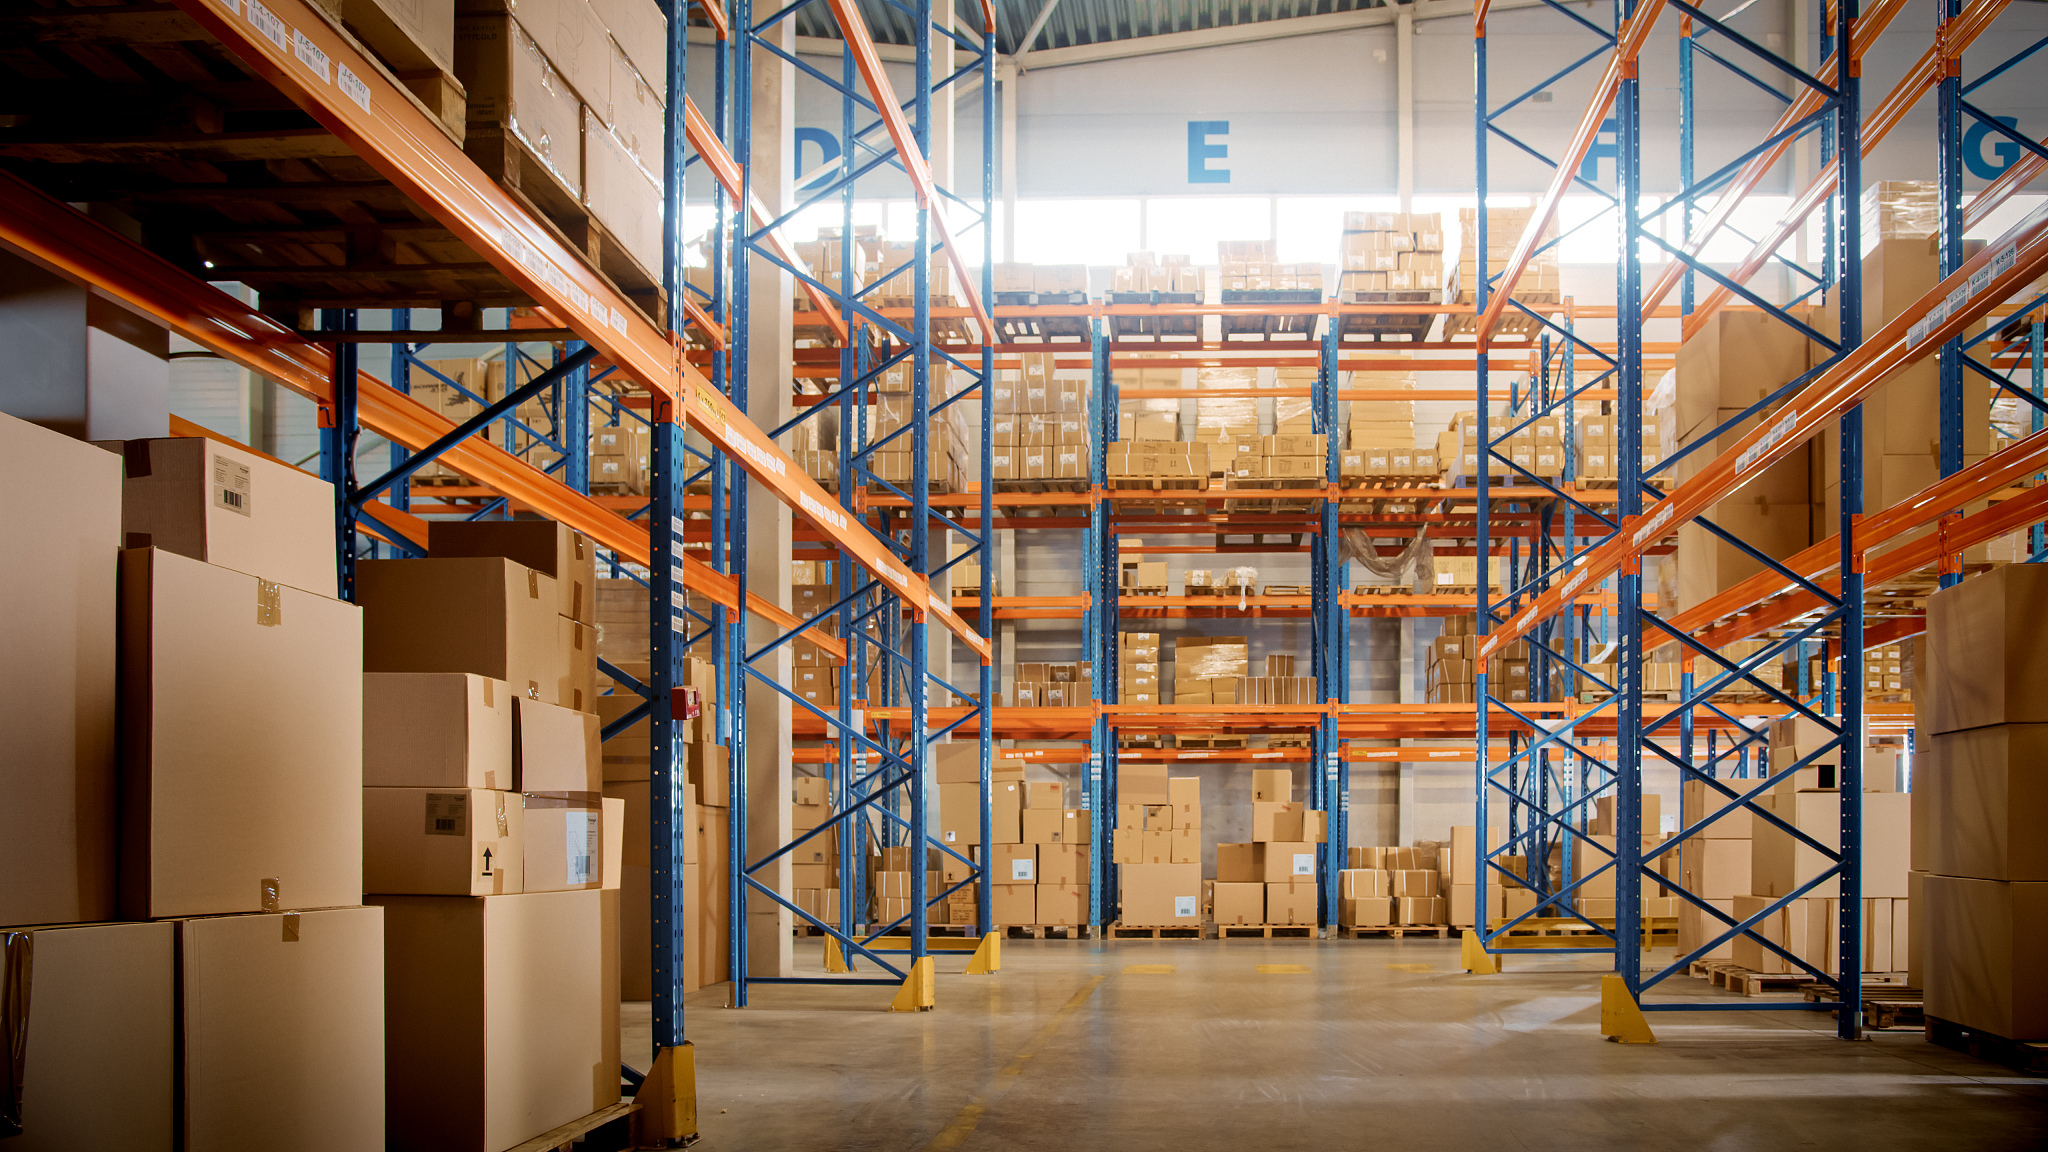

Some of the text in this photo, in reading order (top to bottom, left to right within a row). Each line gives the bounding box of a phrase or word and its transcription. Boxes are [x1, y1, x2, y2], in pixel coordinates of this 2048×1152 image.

[297, 35, 325, 63] J-5-107
[341, 66, 367, 94] J-6-107
[795, 127, 842, 190] D
[1188, 121, 1231, 183] E
[1962, 116, 2021, 180] G
